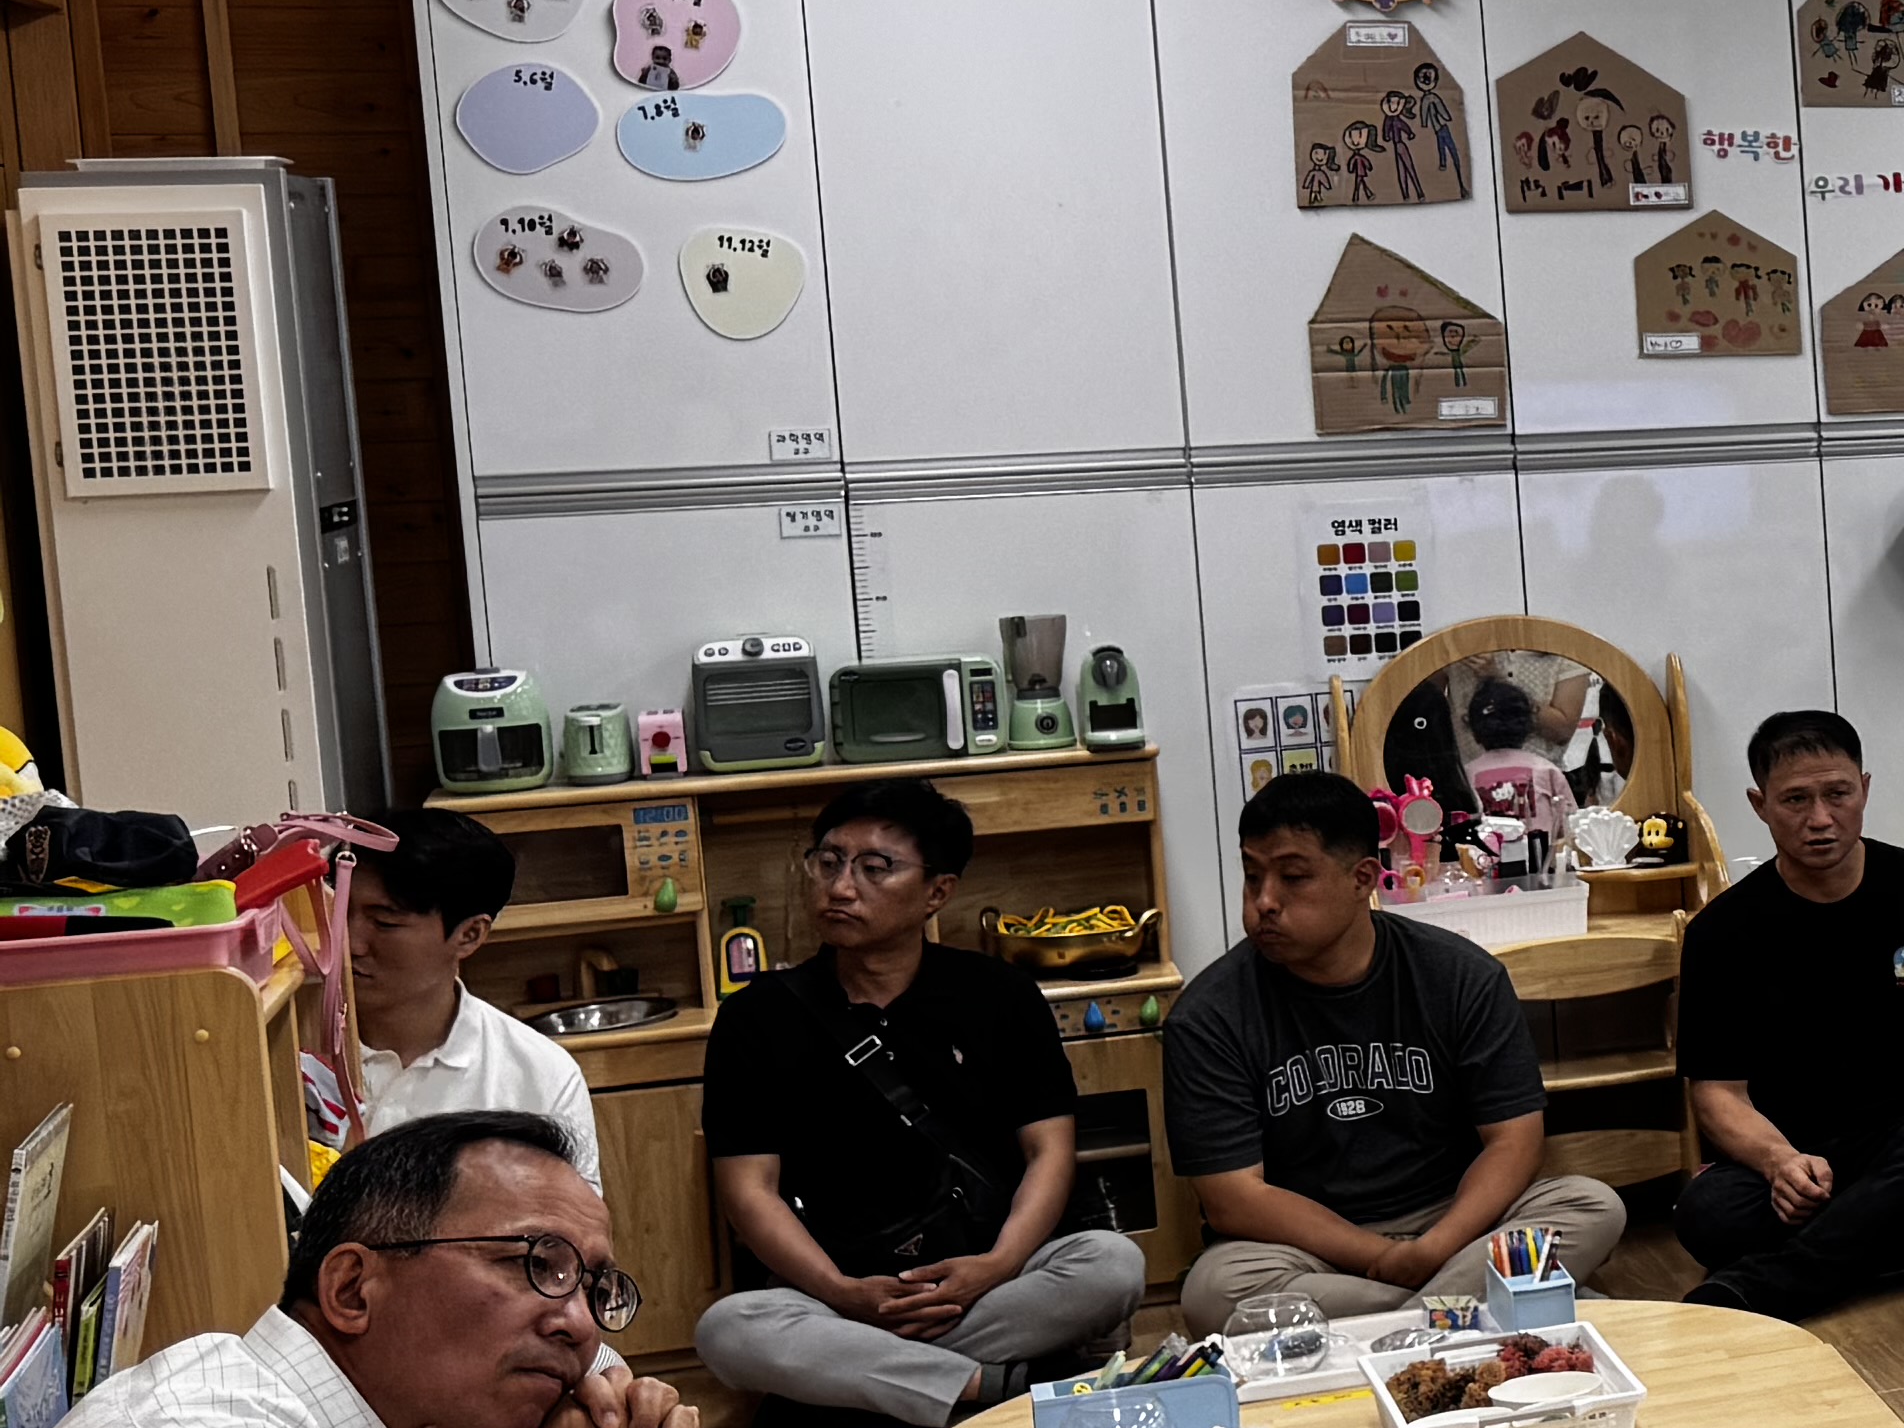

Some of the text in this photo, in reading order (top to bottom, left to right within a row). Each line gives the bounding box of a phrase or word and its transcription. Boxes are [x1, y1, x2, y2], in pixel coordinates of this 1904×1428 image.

[1702, 129, 1796, 162] 행복한
[1809, 174, 1865, 201] 우리
[1331, 518, 1363, 537] 염색
